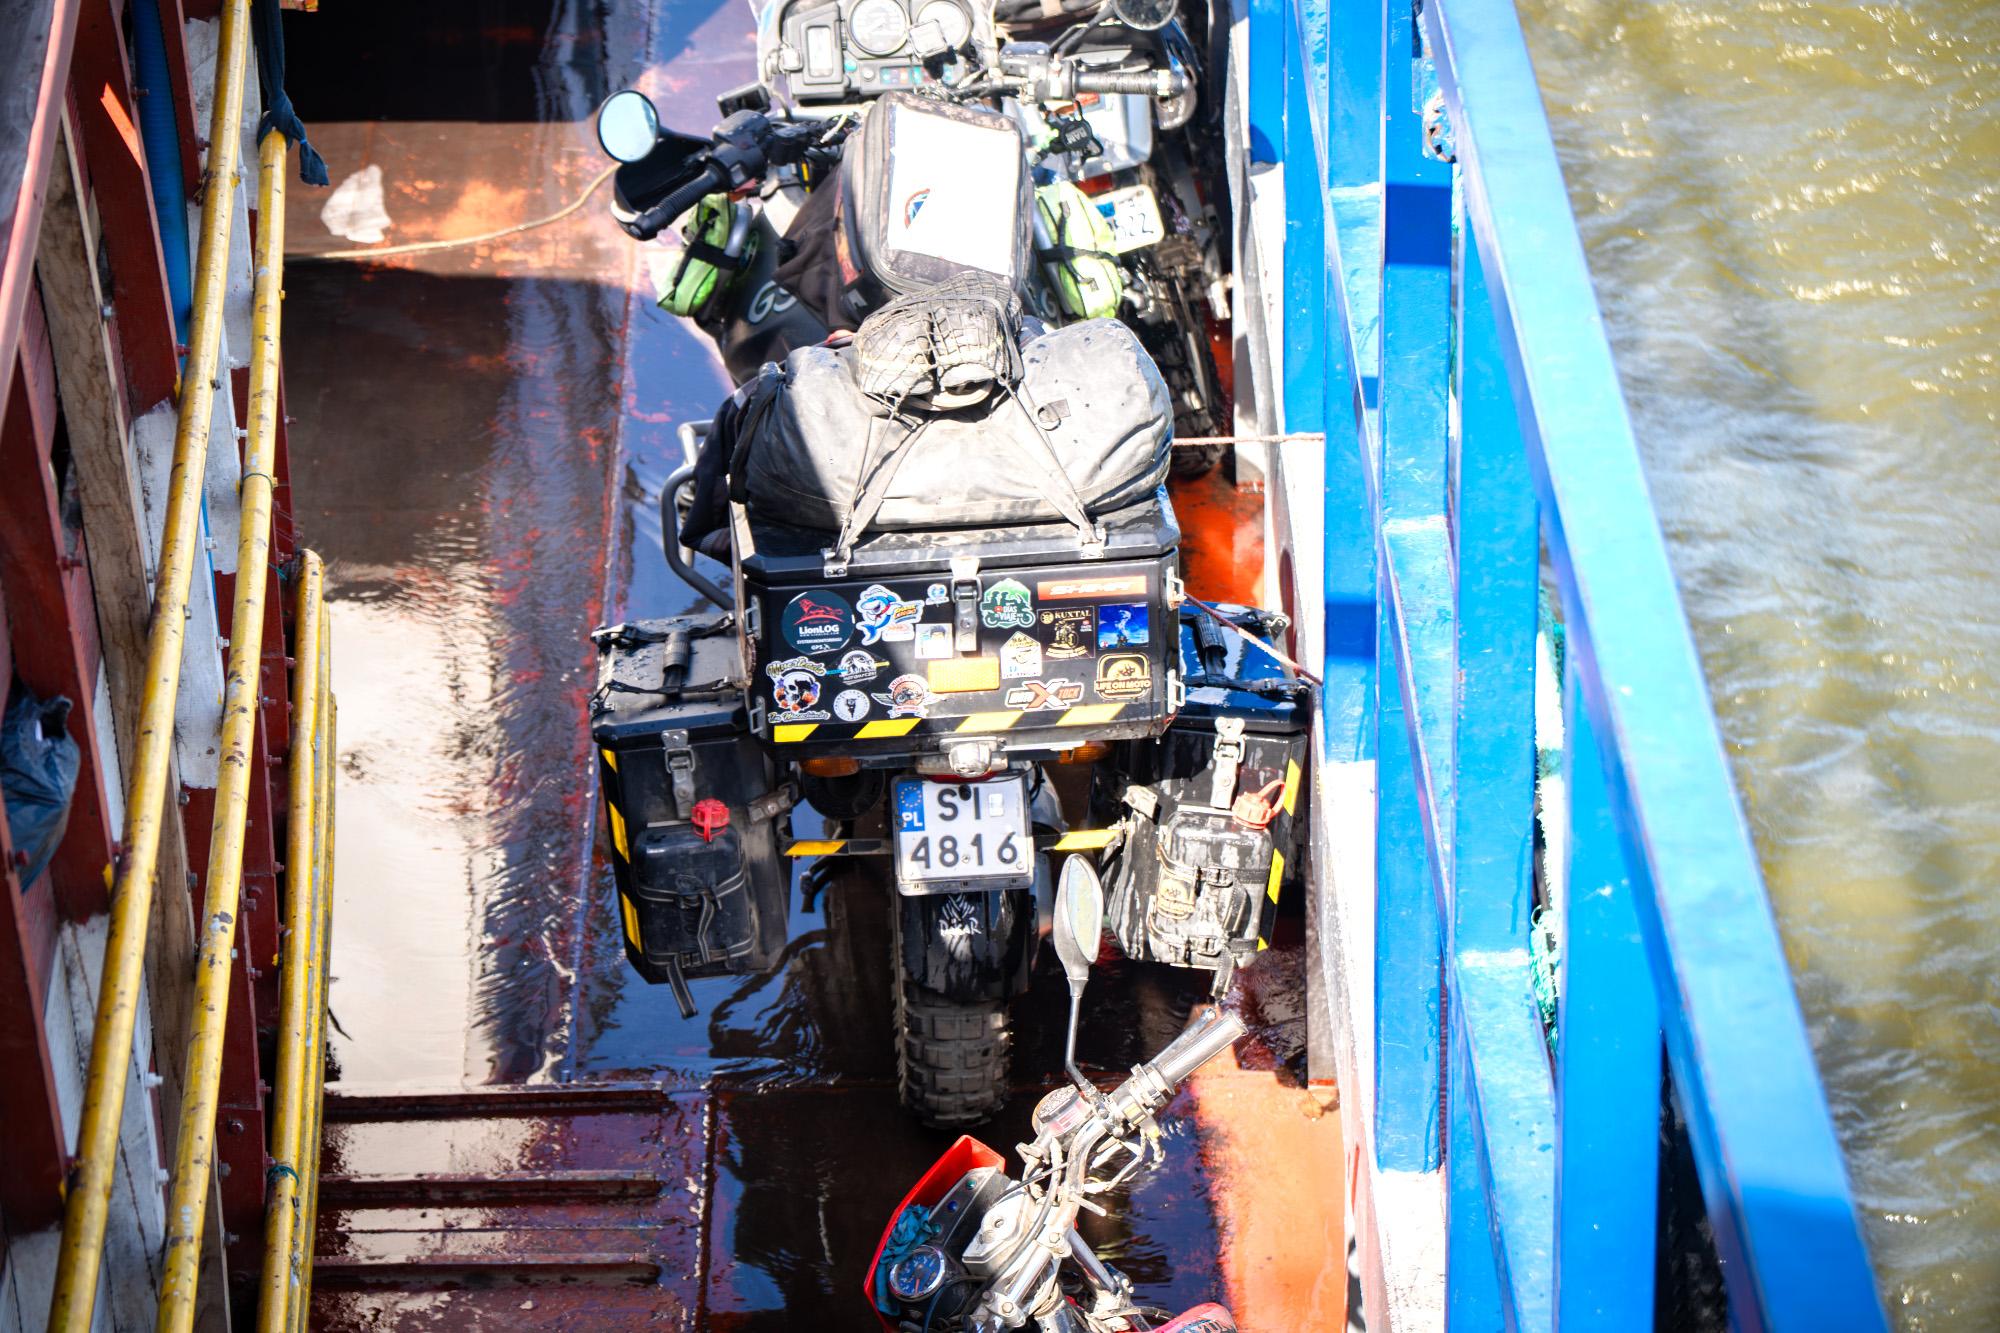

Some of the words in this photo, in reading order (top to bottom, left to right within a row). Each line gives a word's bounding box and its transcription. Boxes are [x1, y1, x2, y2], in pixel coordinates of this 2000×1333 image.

[1055, 610, 1091, 619] KUXTAL
[799, 624, 839, 634] LionLOG
[1096, 682, 1112, 691] LIFE
[1113, 681, 1126, 690] ON
[1127, 680, 1151, 689] MOTO
[938, 787, 981, 821] SI
[902, 812, 922, 827] PL
[910, 831, 1018, 869] 4816
